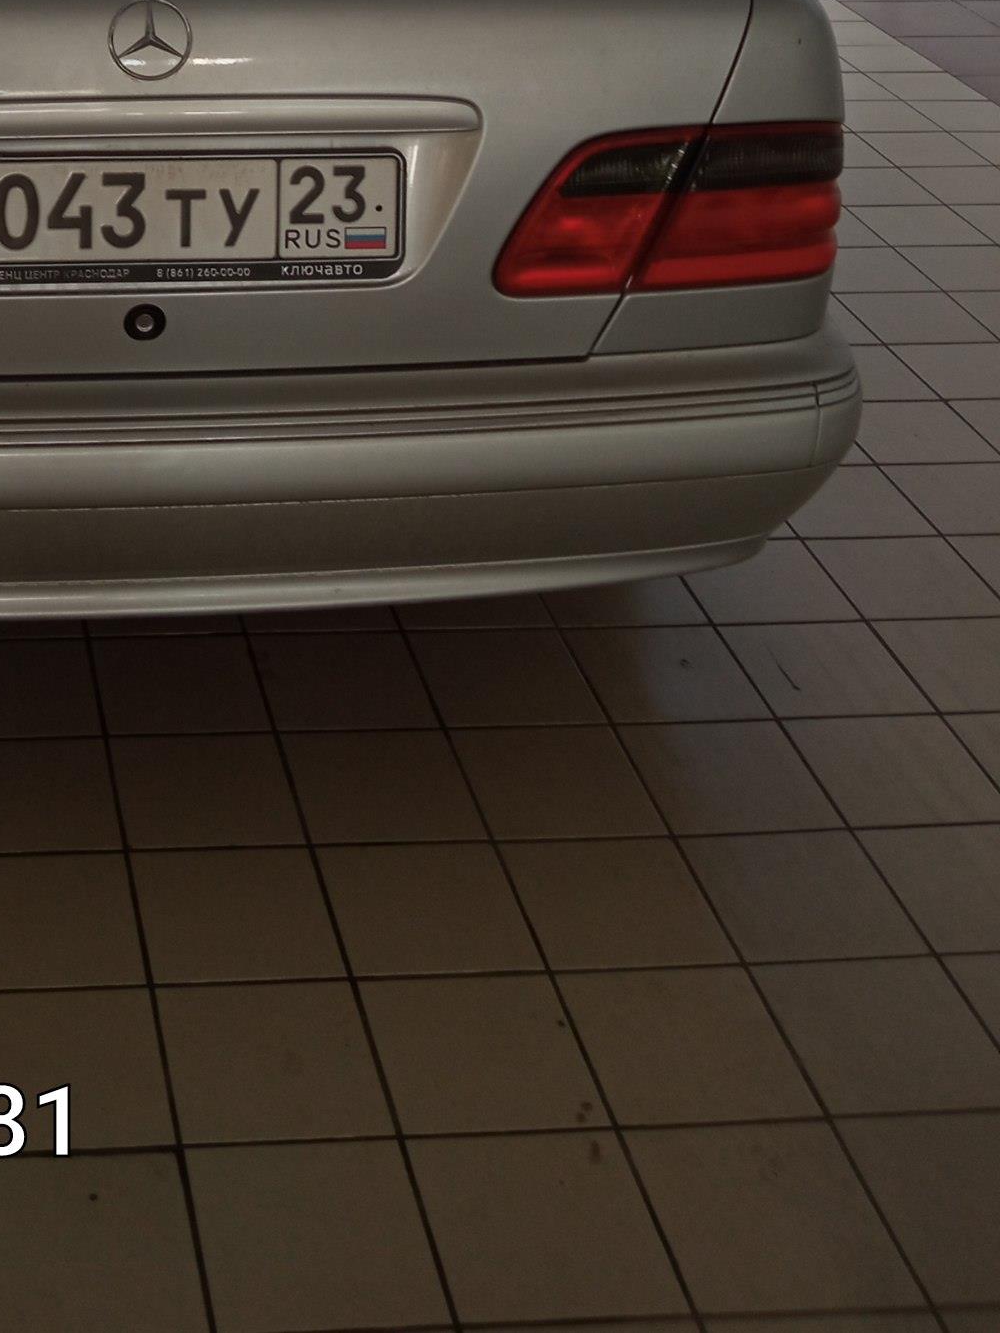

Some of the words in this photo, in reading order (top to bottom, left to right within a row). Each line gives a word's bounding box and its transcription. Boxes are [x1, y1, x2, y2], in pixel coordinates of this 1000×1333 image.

[289, 165, 366, 224] 23
[284, 228, 341, 249] RUS
[156, 268, 164, 278] 8
[166, 267, 195, 280] (861)
[197, 267, 251, 278] 260-00-00
